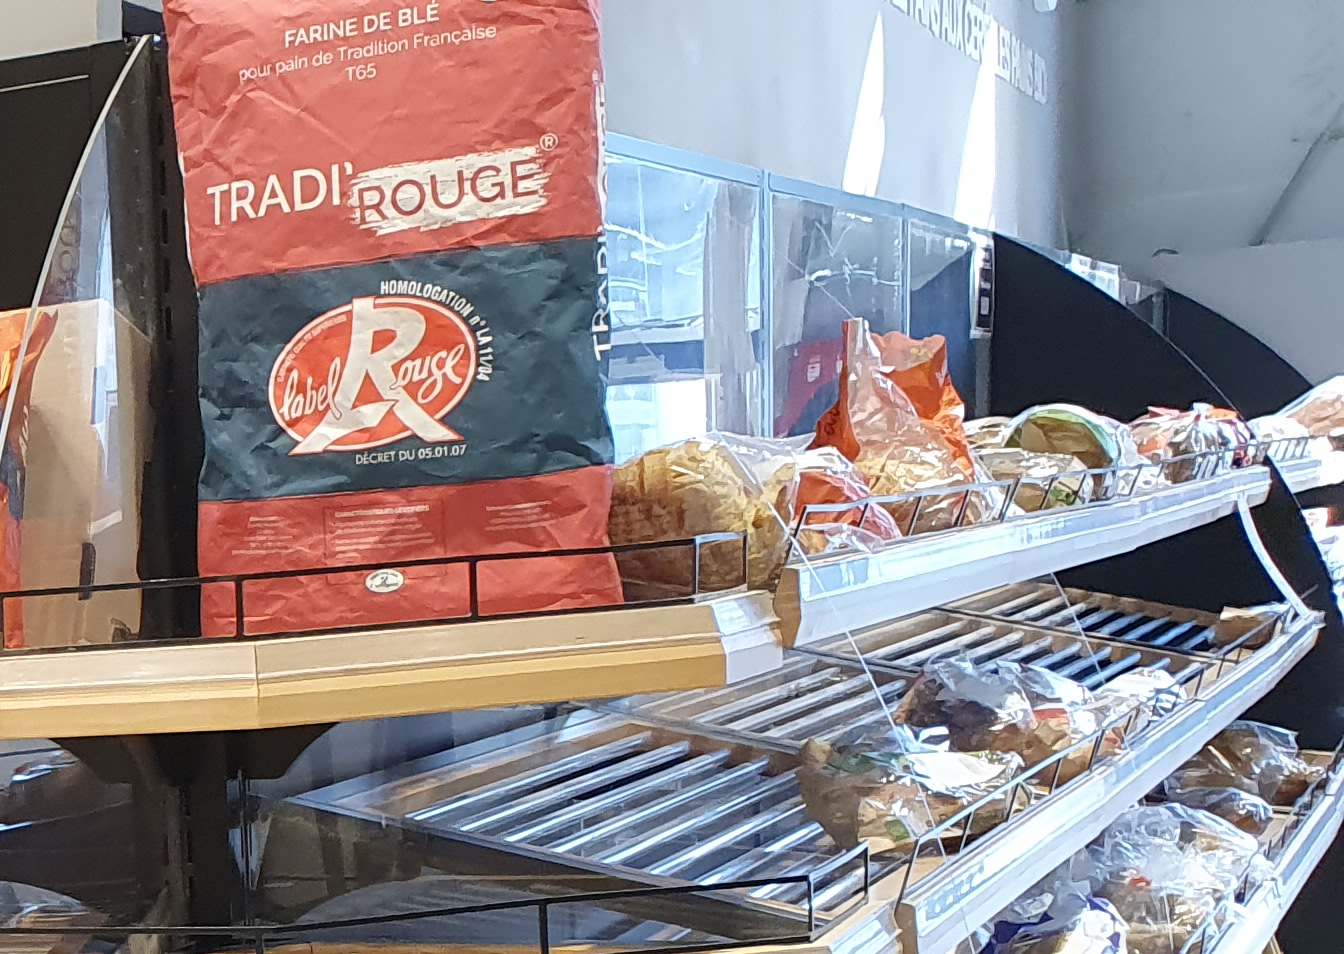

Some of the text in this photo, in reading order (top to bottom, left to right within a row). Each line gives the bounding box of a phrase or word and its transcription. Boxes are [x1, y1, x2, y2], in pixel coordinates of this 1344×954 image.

[284, 2, 440, 48] FARINE DE BLÉ
[238, 24, 497, 84] pour pain de Tradition Française
[345, 64, 377, 82] T65
[357, 158, 539, 226] ROUGE
[380, 280, 474, 317] HOMOLOGATION
[475, 327, 493, 345] LA
[476, 346, 494, 381] 11/04
[278, 357, 343, 422] label
[355, 444, 467, 465] DÉCRET DU 05.01.07
